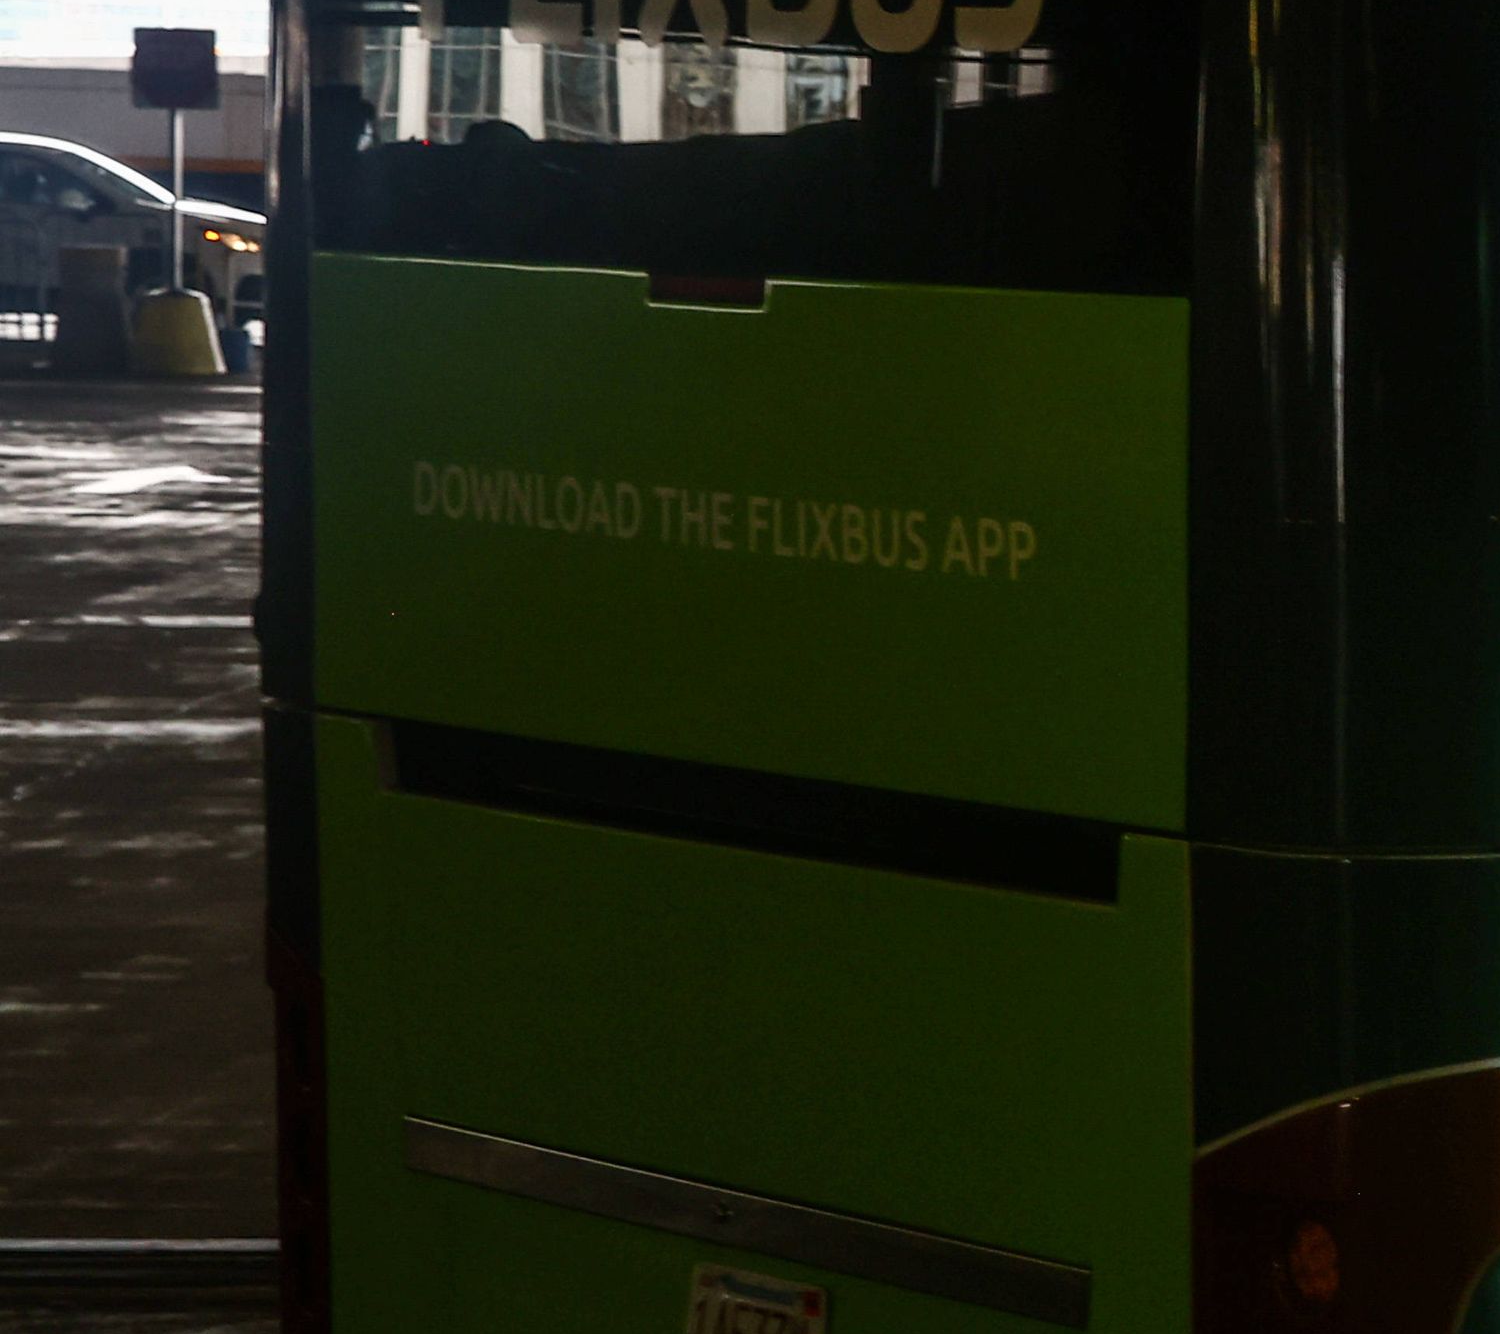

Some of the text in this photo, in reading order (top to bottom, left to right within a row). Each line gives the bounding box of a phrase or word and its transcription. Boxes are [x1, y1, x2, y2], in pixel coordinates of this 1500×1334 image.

[412, 460, 1038, 580] DOWNLOAD THE FLIXBUS APP
